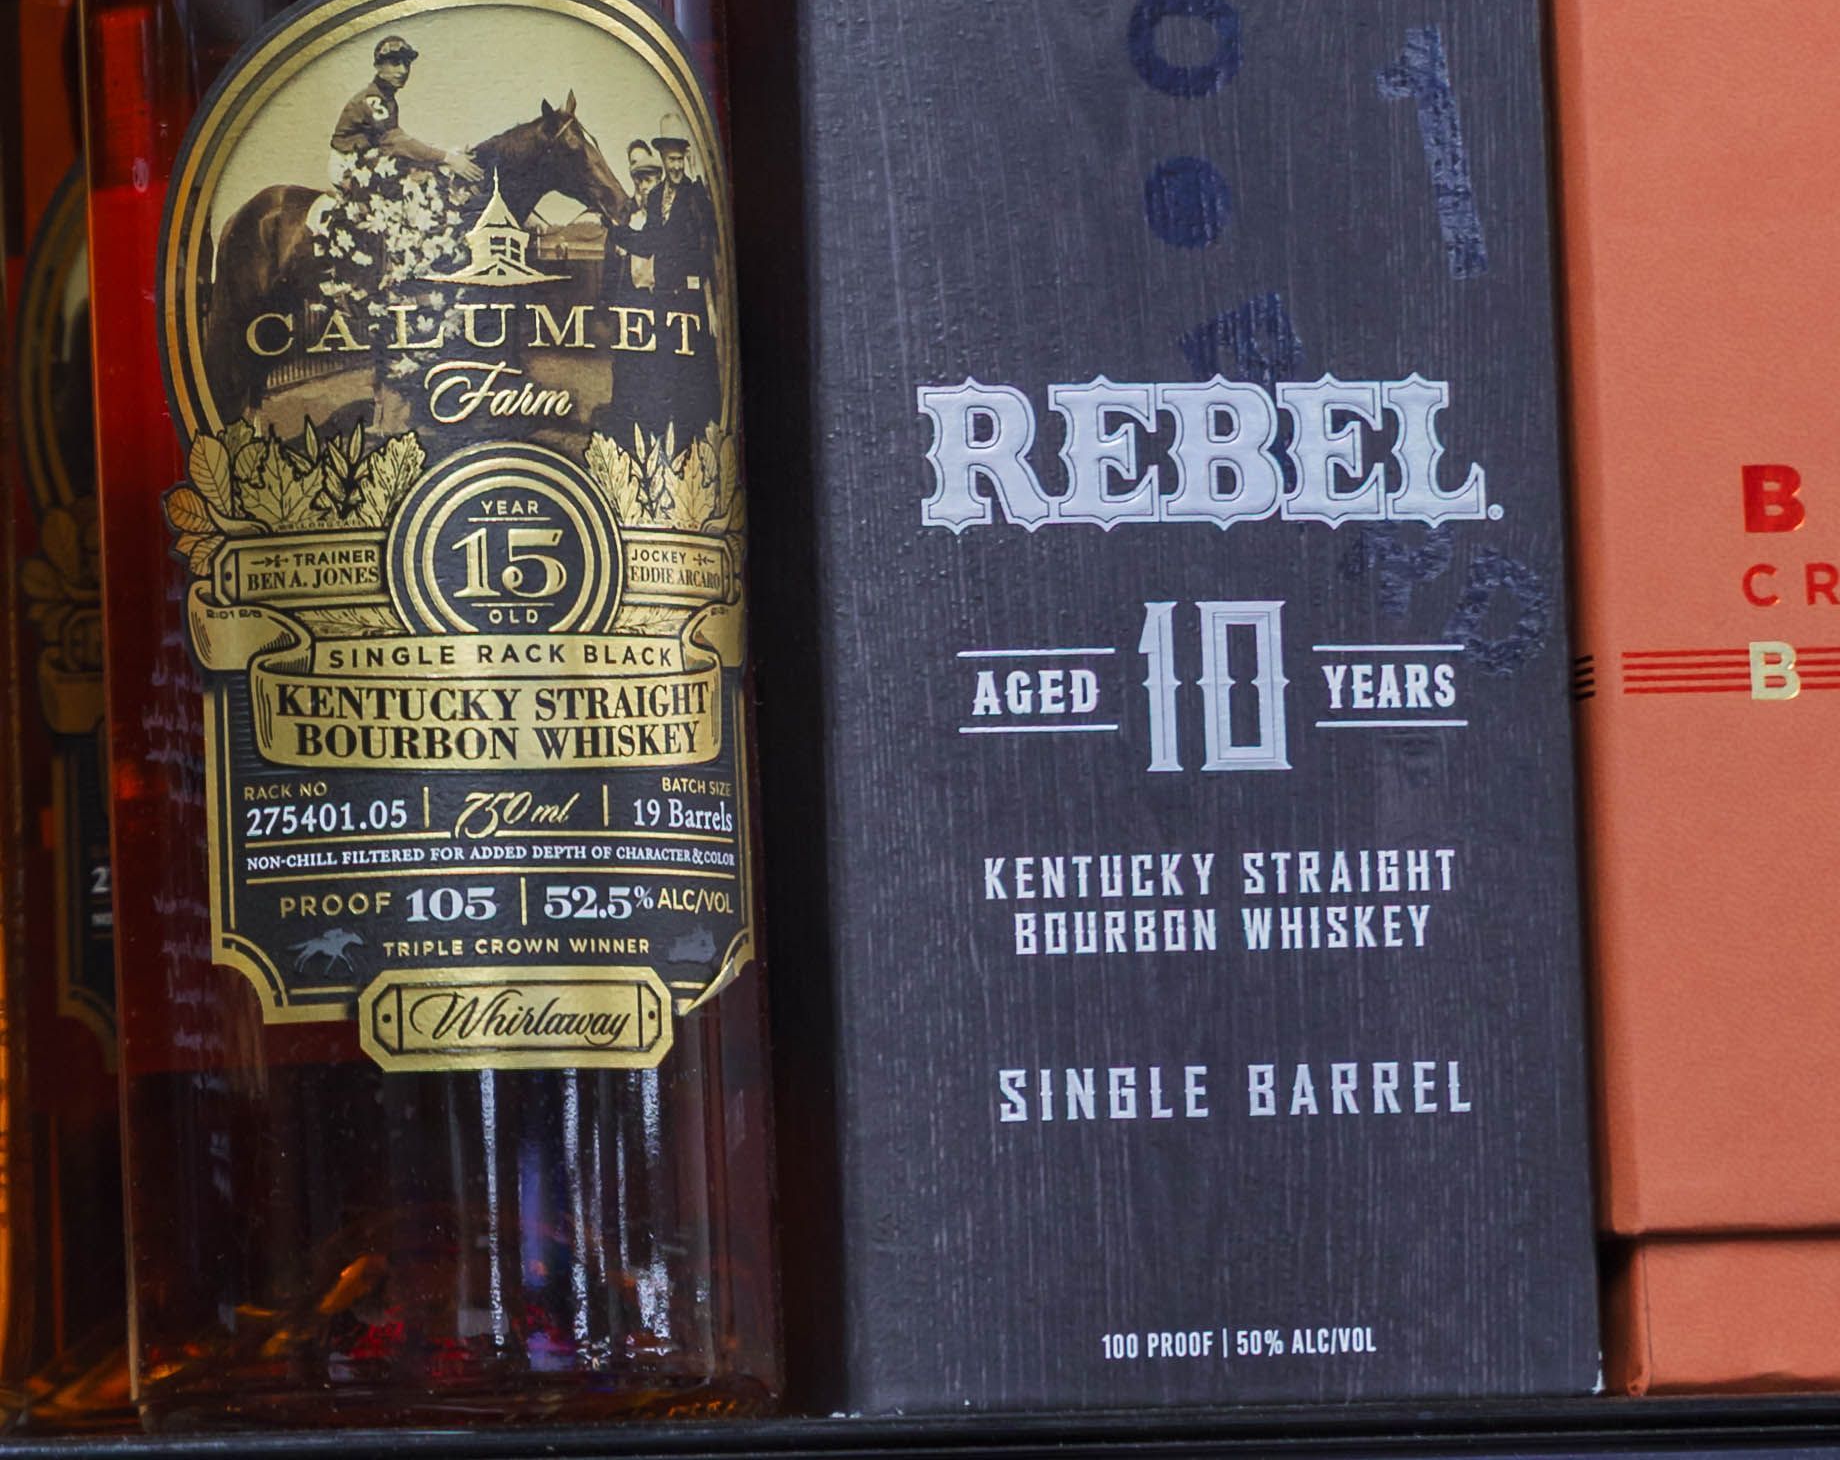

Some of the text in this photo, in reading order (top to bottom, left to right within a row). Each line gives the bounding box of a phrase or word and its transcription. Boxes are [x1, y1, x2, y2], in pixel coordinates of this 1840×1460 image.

[245, 304, 701, 358] CALUMET
[424, 359, 574, 424] Farm
[915, 371, 1488, 536] REBEL
[479, 498, 540, 518] YEAR
[293, 548, 377, 568] TRAINER
[450, 527, 568, 599] 15
[631, 548, 687, 565] JOCKEY
[247, 568, 380, 592] BEN A. JONES
[630, 565, 674, 585] EDDIE
[488, 609, 539, 626] OLD
[328, 643, 673, 669] SINGLE RACK BLACK
[1749, 640, 1801, 701] B
[275, 678, 710, 722] KENTUCKY STRAIGHT
[971, 600, 1457, 773] AGED 10 YEARS
[294, 721, 700, 760] BOURBON WHISKEY
[244, 780, 328, 801] RACK NO
[661, 776, 732, 797] BATCH SIZE
[245, 799, 408, 838] 275401.05
[454, 790, 533, 840] 750
[632, 798, 734, 833] 19 Barrels
[246, 851, 338, 871] NON-CHILL
[341, 846, 425, 865] FILTERED
[430, 846, 465, 862] FOR
[470, 845, 528, 861] ADDED
[532, 844, 588, 860] DEPTH
[591, 845, 612, 861] OF
[983, 849, 1456, 901] KENTUCKY STRAIGHT
[280, 886, 498, 922] PROOF 105
[543, 885, 735, 920] 52.5% ALC/VOL
[383, 937, 651, 958] TRIPLE CROWN WINNER
[1014, 904, 1432, 956] BOURBON WHISKEY
[409, 988, 633, 1048] Whirlaway
[999, 1060, 1472, 1123] SINGLE BARREL
[1101, 1326, 1377, 1360] 100 PROOF 50% ALC/VOL
